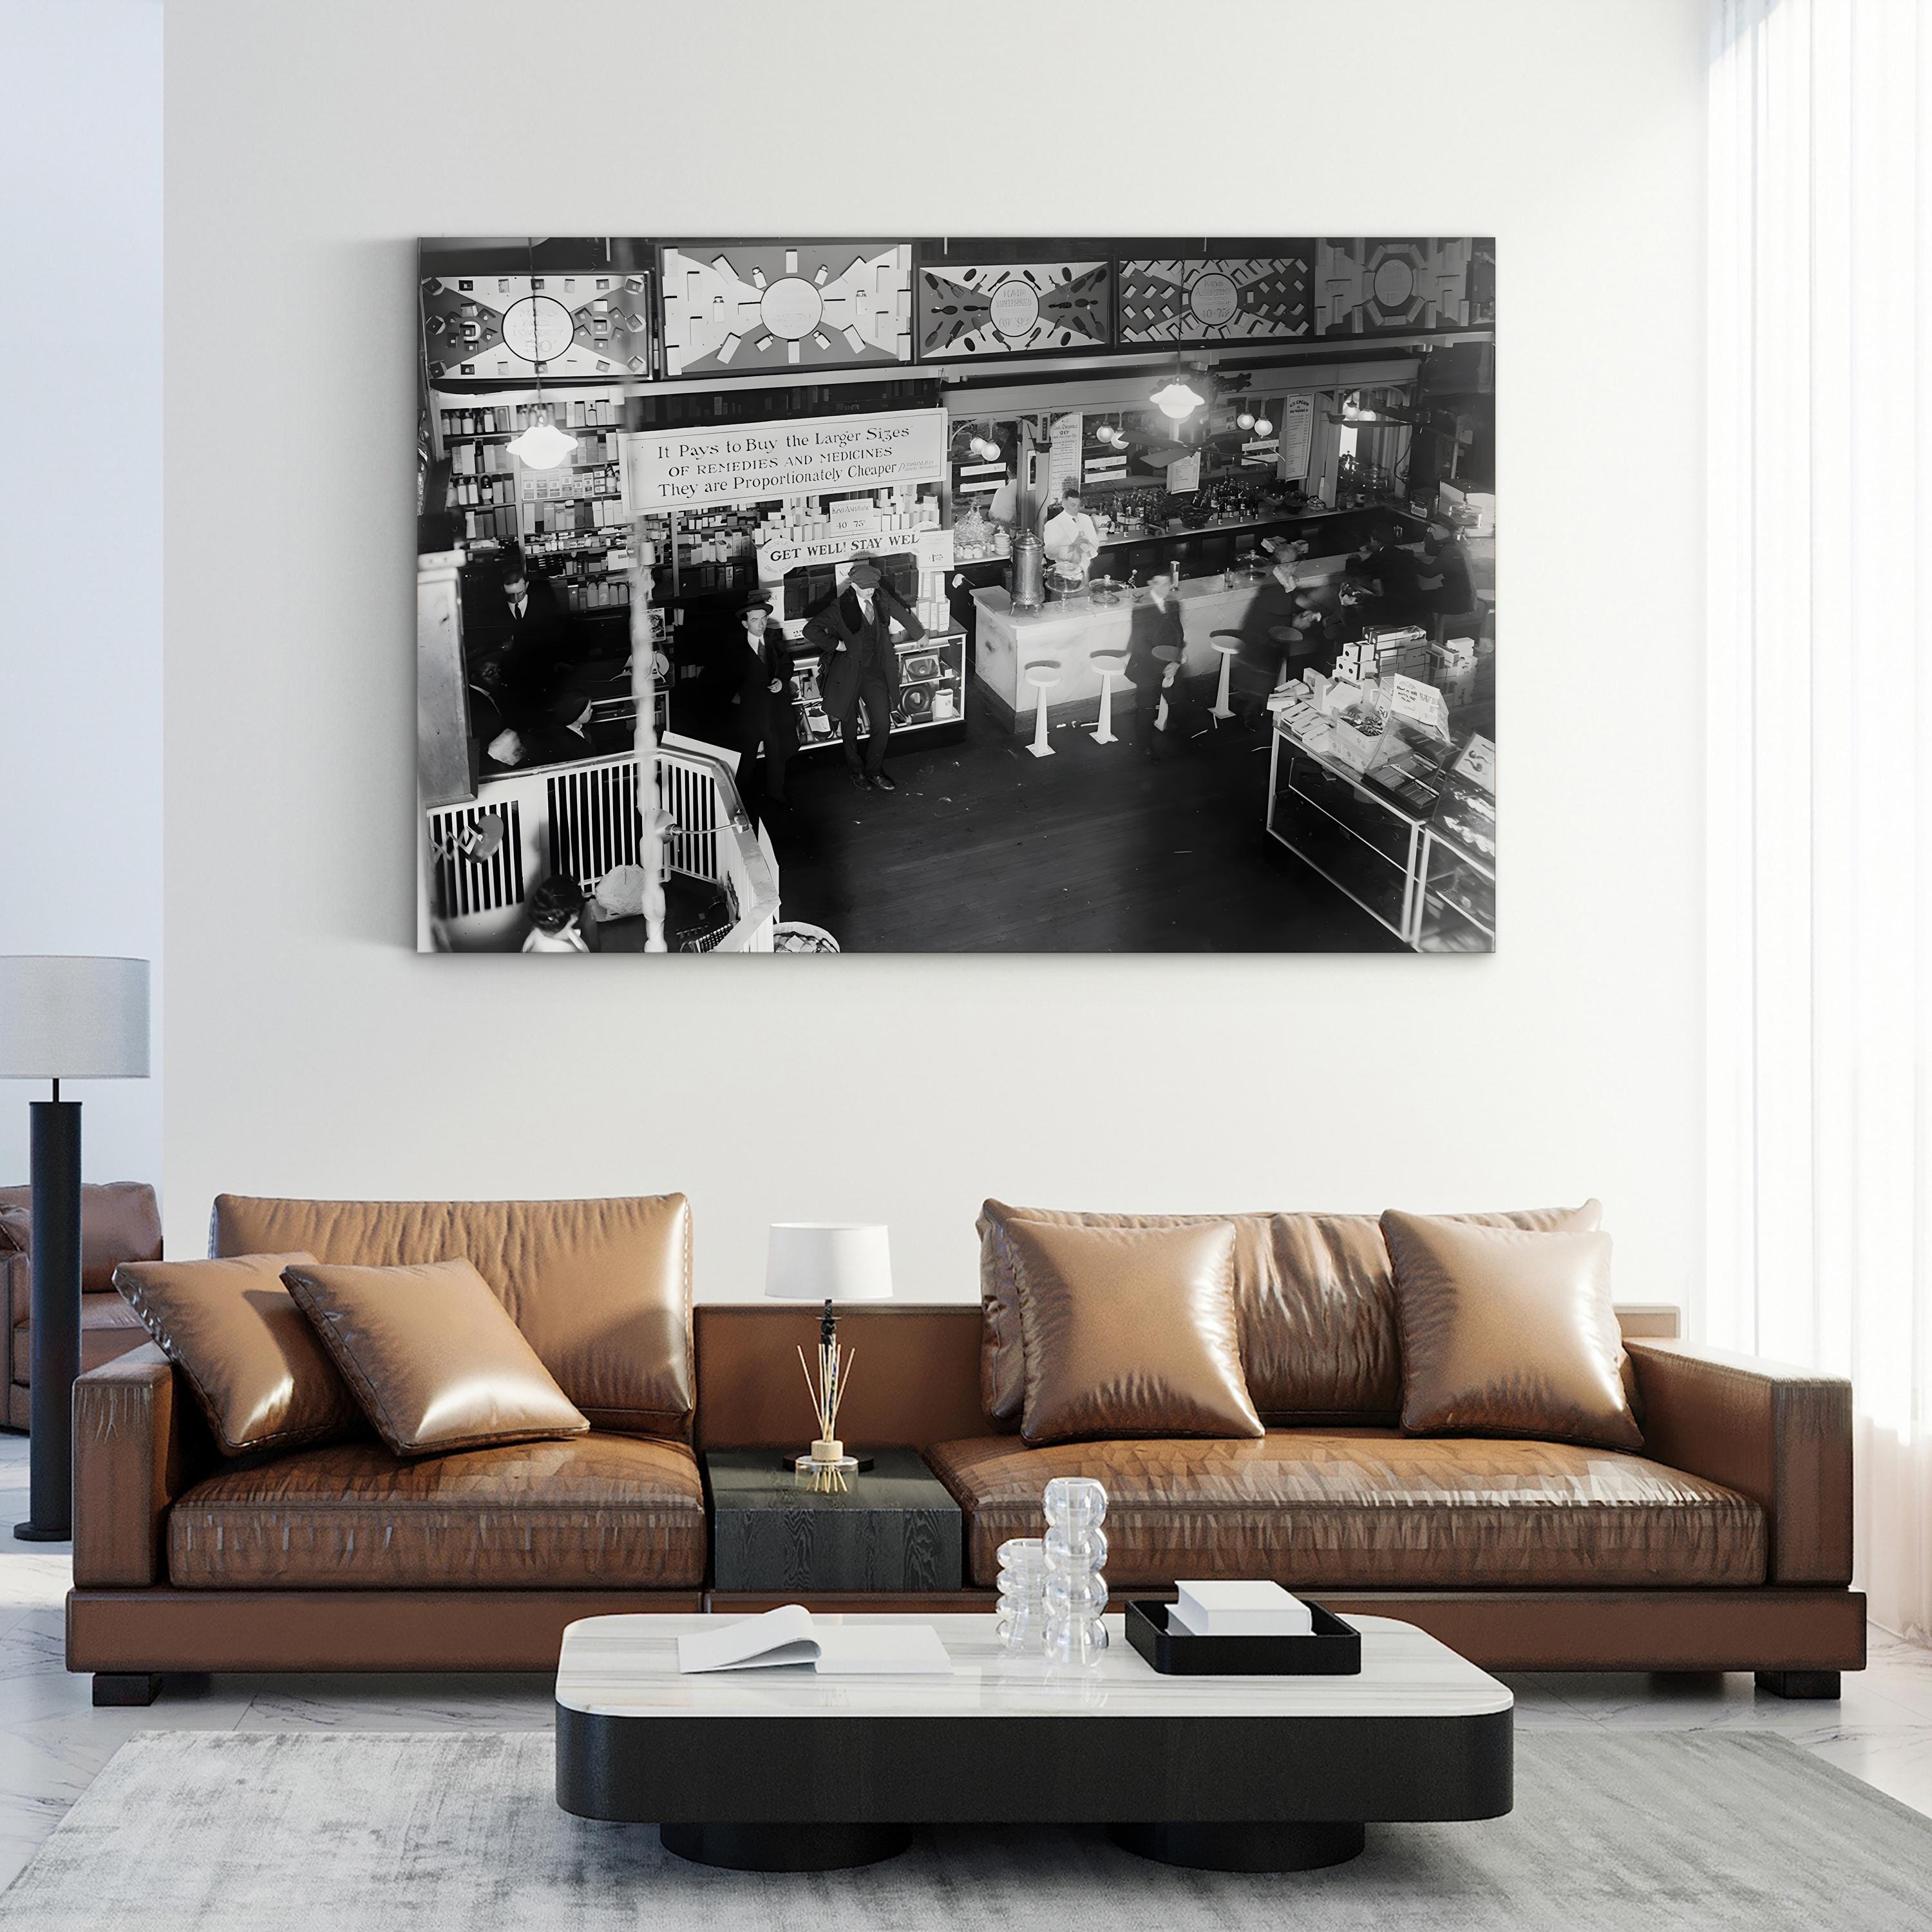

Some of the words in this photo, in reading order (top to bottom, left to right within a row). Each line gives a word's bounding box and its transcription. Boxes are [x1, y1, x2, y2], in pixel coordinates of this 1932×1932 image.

[658, 446, 670, 459] It
[679, 444, 719, 460] Pays
[726, 440, 742, 453] to
[745, 438, 778, 454] Buy
[786, 435, 809, 448] the
[815, 431, 861, 448] Larger
[866, 428, 909, 442] Sizes
[668, 466, 690, 477] OF
[697, 458, 779, 475] REMEDIES
[785, 455, 813, 466] AND
[820, 447, 893, 463] MEDICINES
[656, 483, 699, 499] They
[704, 481, 728, 493] are
[733, 468, 843, 489] Proportionately
[848, 464, 897, 478] Cheaper
[770, 547, 802, 562] GET
[806, 542, 846, 556] WELL!
[850, 538, 883, 552] STAY
[888, 533, 920, 546] WEL
